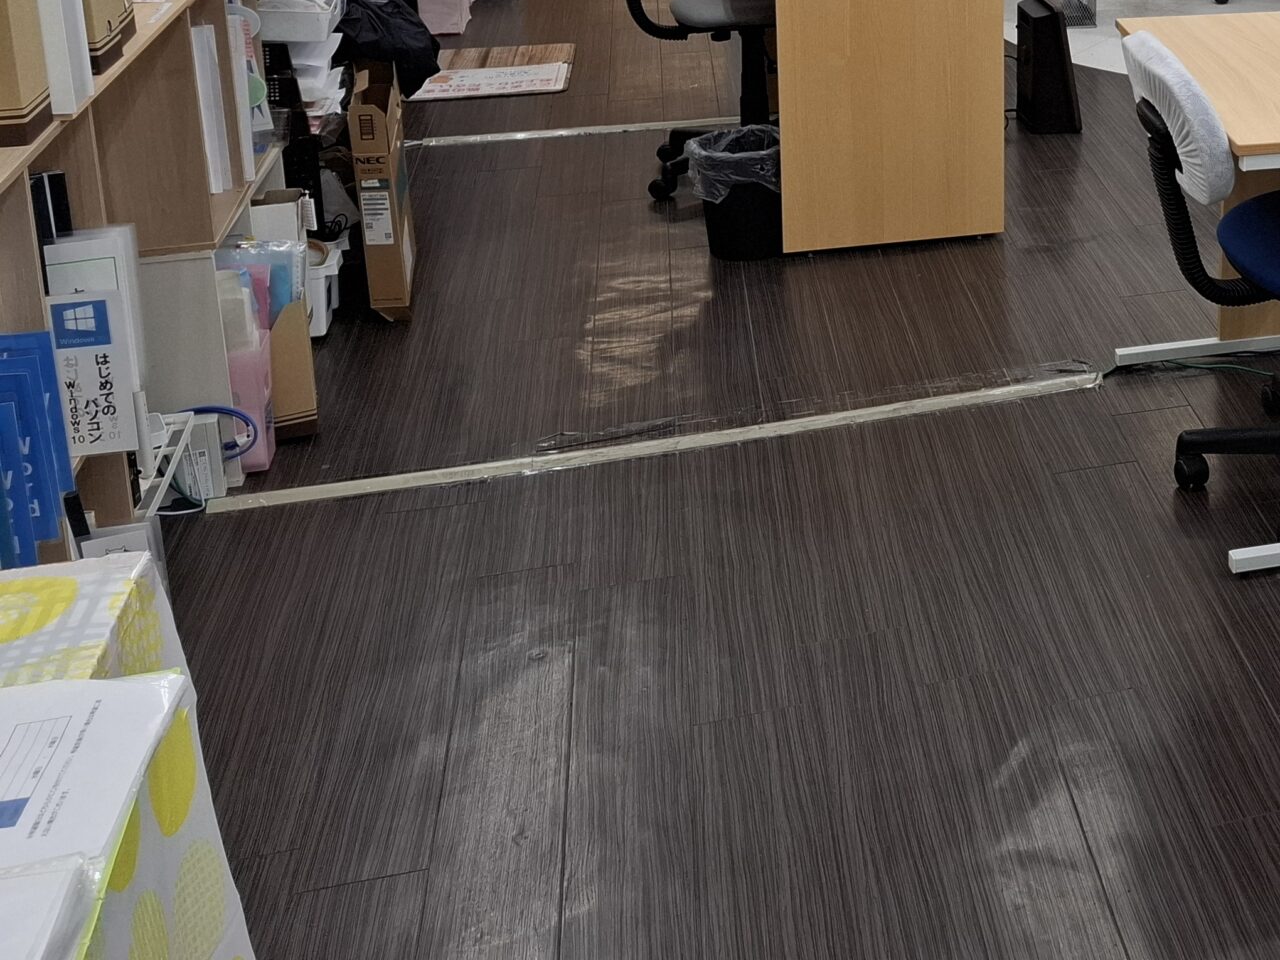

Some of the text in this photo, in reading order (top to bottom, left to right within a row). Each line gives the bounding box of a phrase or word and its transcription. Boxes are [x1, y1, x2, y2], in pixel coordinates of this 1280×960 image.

[355, 156, 386, 165] NEC
[95, 353, 117, 416] はじめての
[65, 381, 85, 445] Windows 10
[84, 398, 103, 444] パソコン
